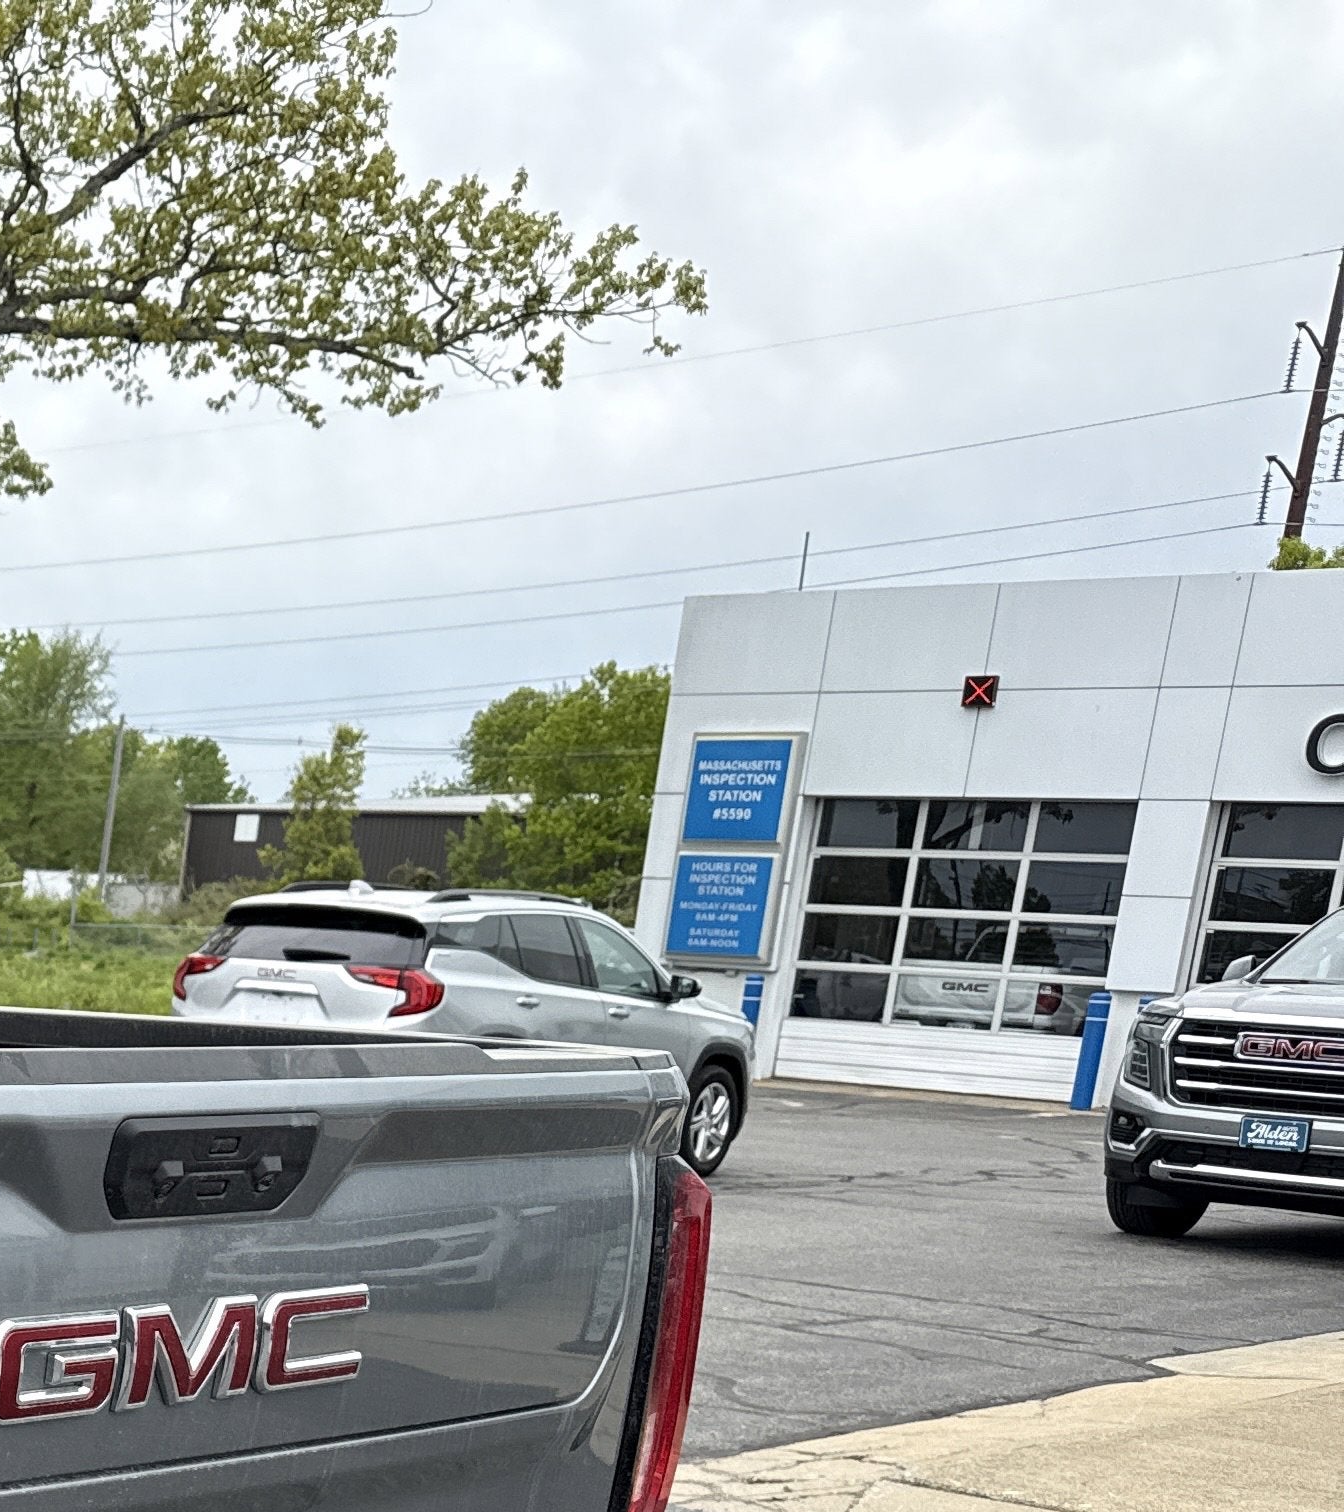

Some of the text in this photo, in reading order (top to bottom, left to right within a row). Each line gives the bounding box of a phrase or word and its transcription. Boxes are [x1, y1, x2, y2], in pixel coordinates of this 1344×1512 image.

[698, 760, 782, 771] MASSACHUSETTS
[699, 773, 777, 785] INSPECTION
[708, 790, 762, 802] STATION
[712, 808, 752, 820] #5590
[691, 862, 758, 873] HOURS FOR
[689, 874, 757, 885] INSPECTION
[697, 886, 745, 896] STATION
[689, 928, 740, 937] SATURDAY
[256, 967, 297, 979] GMC
[942, 981, 989, 993] GMC
[1241, 1036, 1344, 1061] GMC
[1246, 1122, 1300, 1141] Alden
